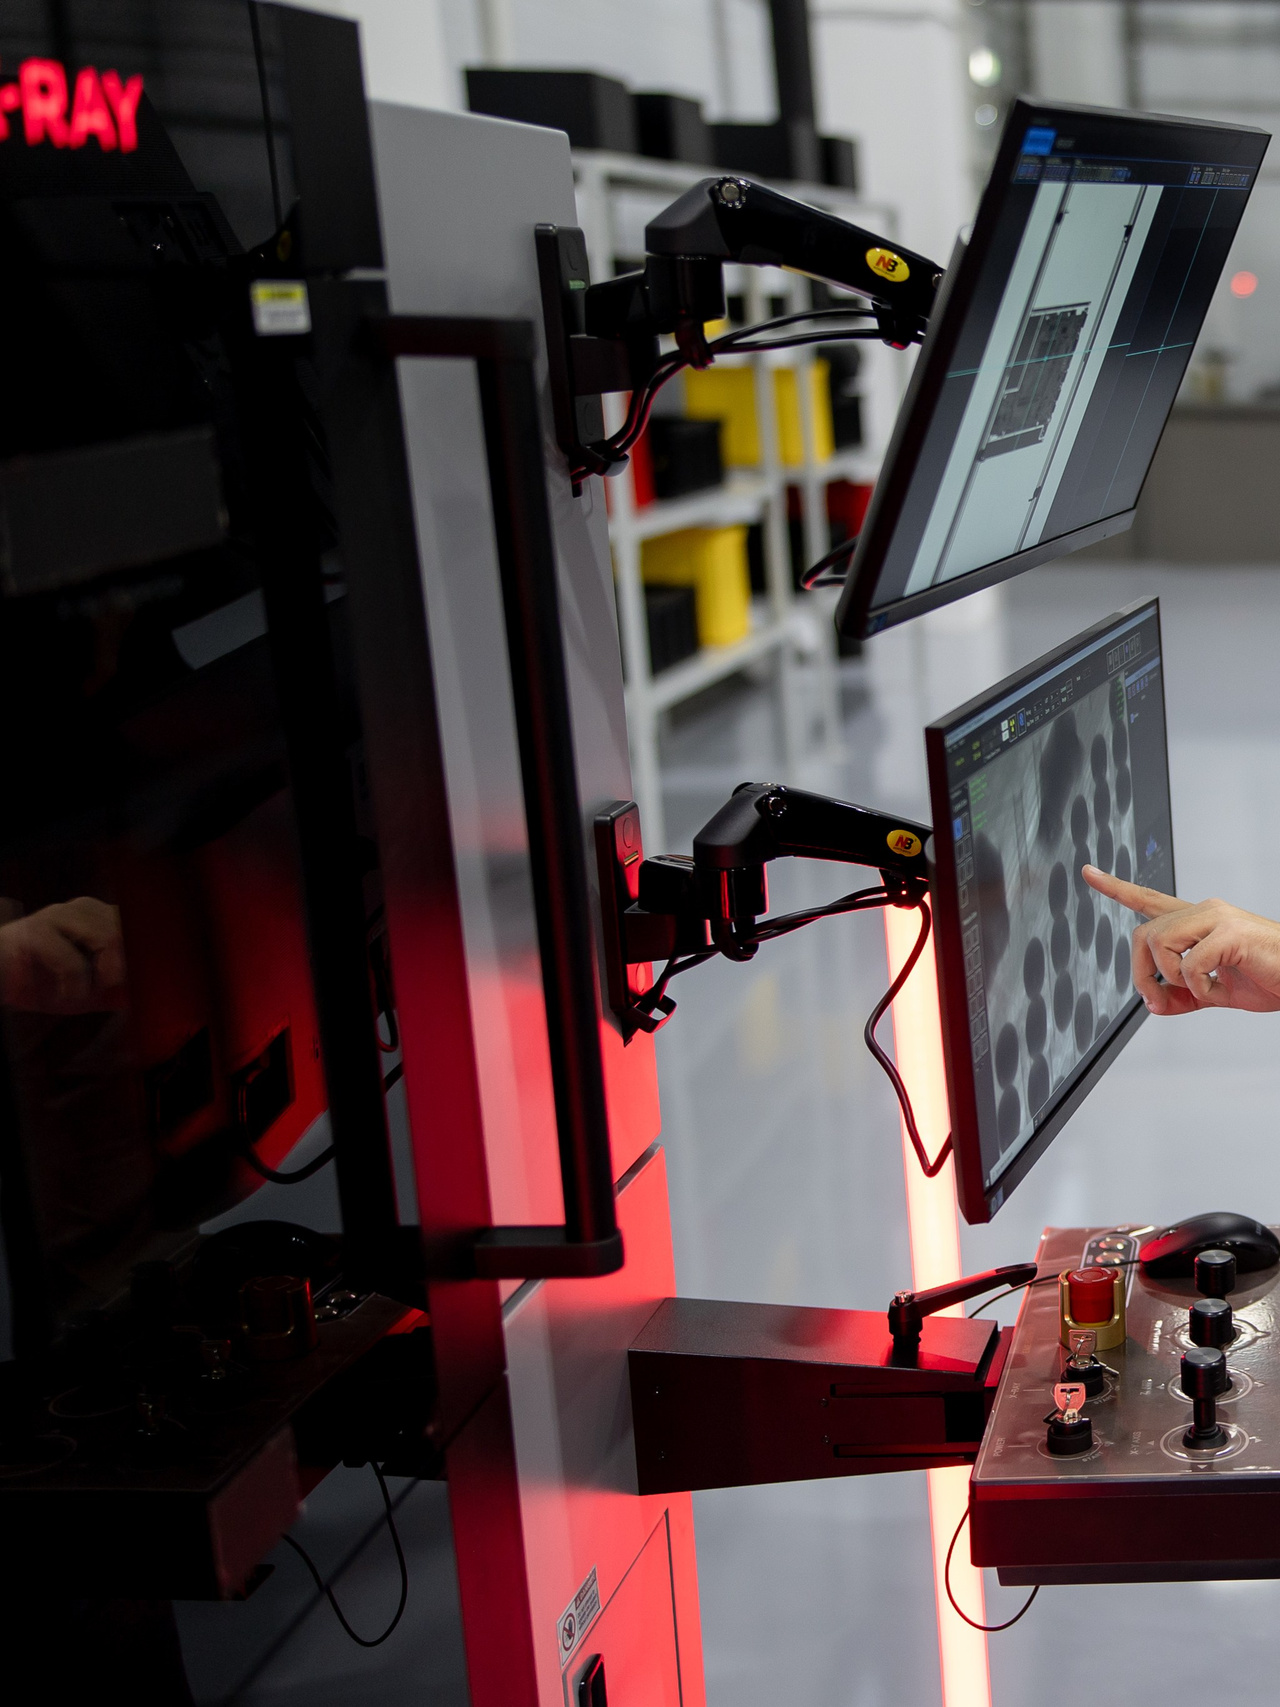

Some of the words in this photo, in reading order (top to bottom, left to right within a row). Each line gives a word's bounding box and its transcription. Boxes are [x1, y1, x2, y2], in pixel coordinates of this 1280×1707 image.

[0, 56, 143, 154] -RAY
[1009, 1382, 1020, 1399] X-RAY
[993, 1437, 1006, 1457] POWER
